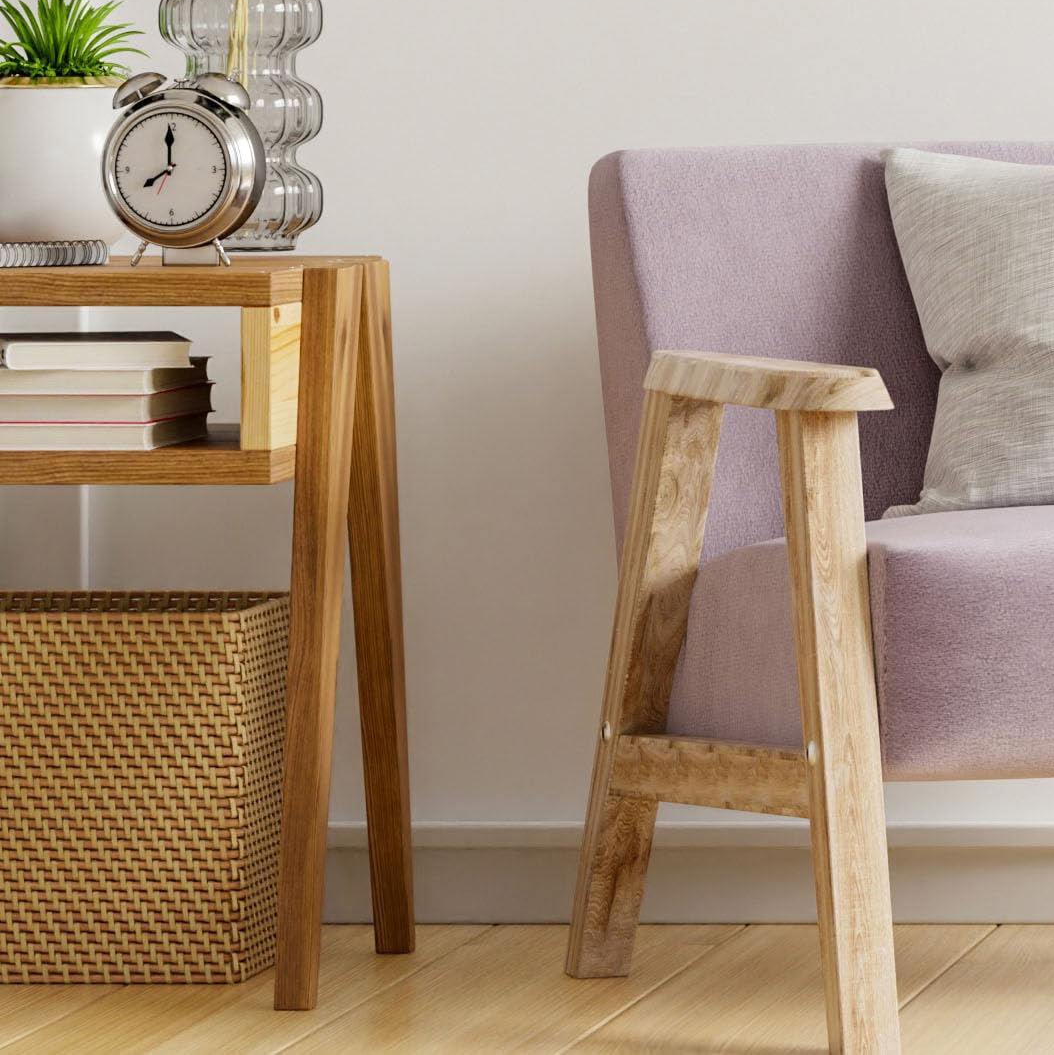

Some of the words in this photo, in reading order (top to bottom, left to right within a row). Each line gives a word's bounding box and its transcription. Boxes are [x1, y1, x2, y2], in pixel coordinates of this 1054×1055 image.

[168, 122, 177, 131] 2
[125, 166, 130, 174] 9
[211, 166, 217, 174] 3
[169, 208, 174, 216] 6
